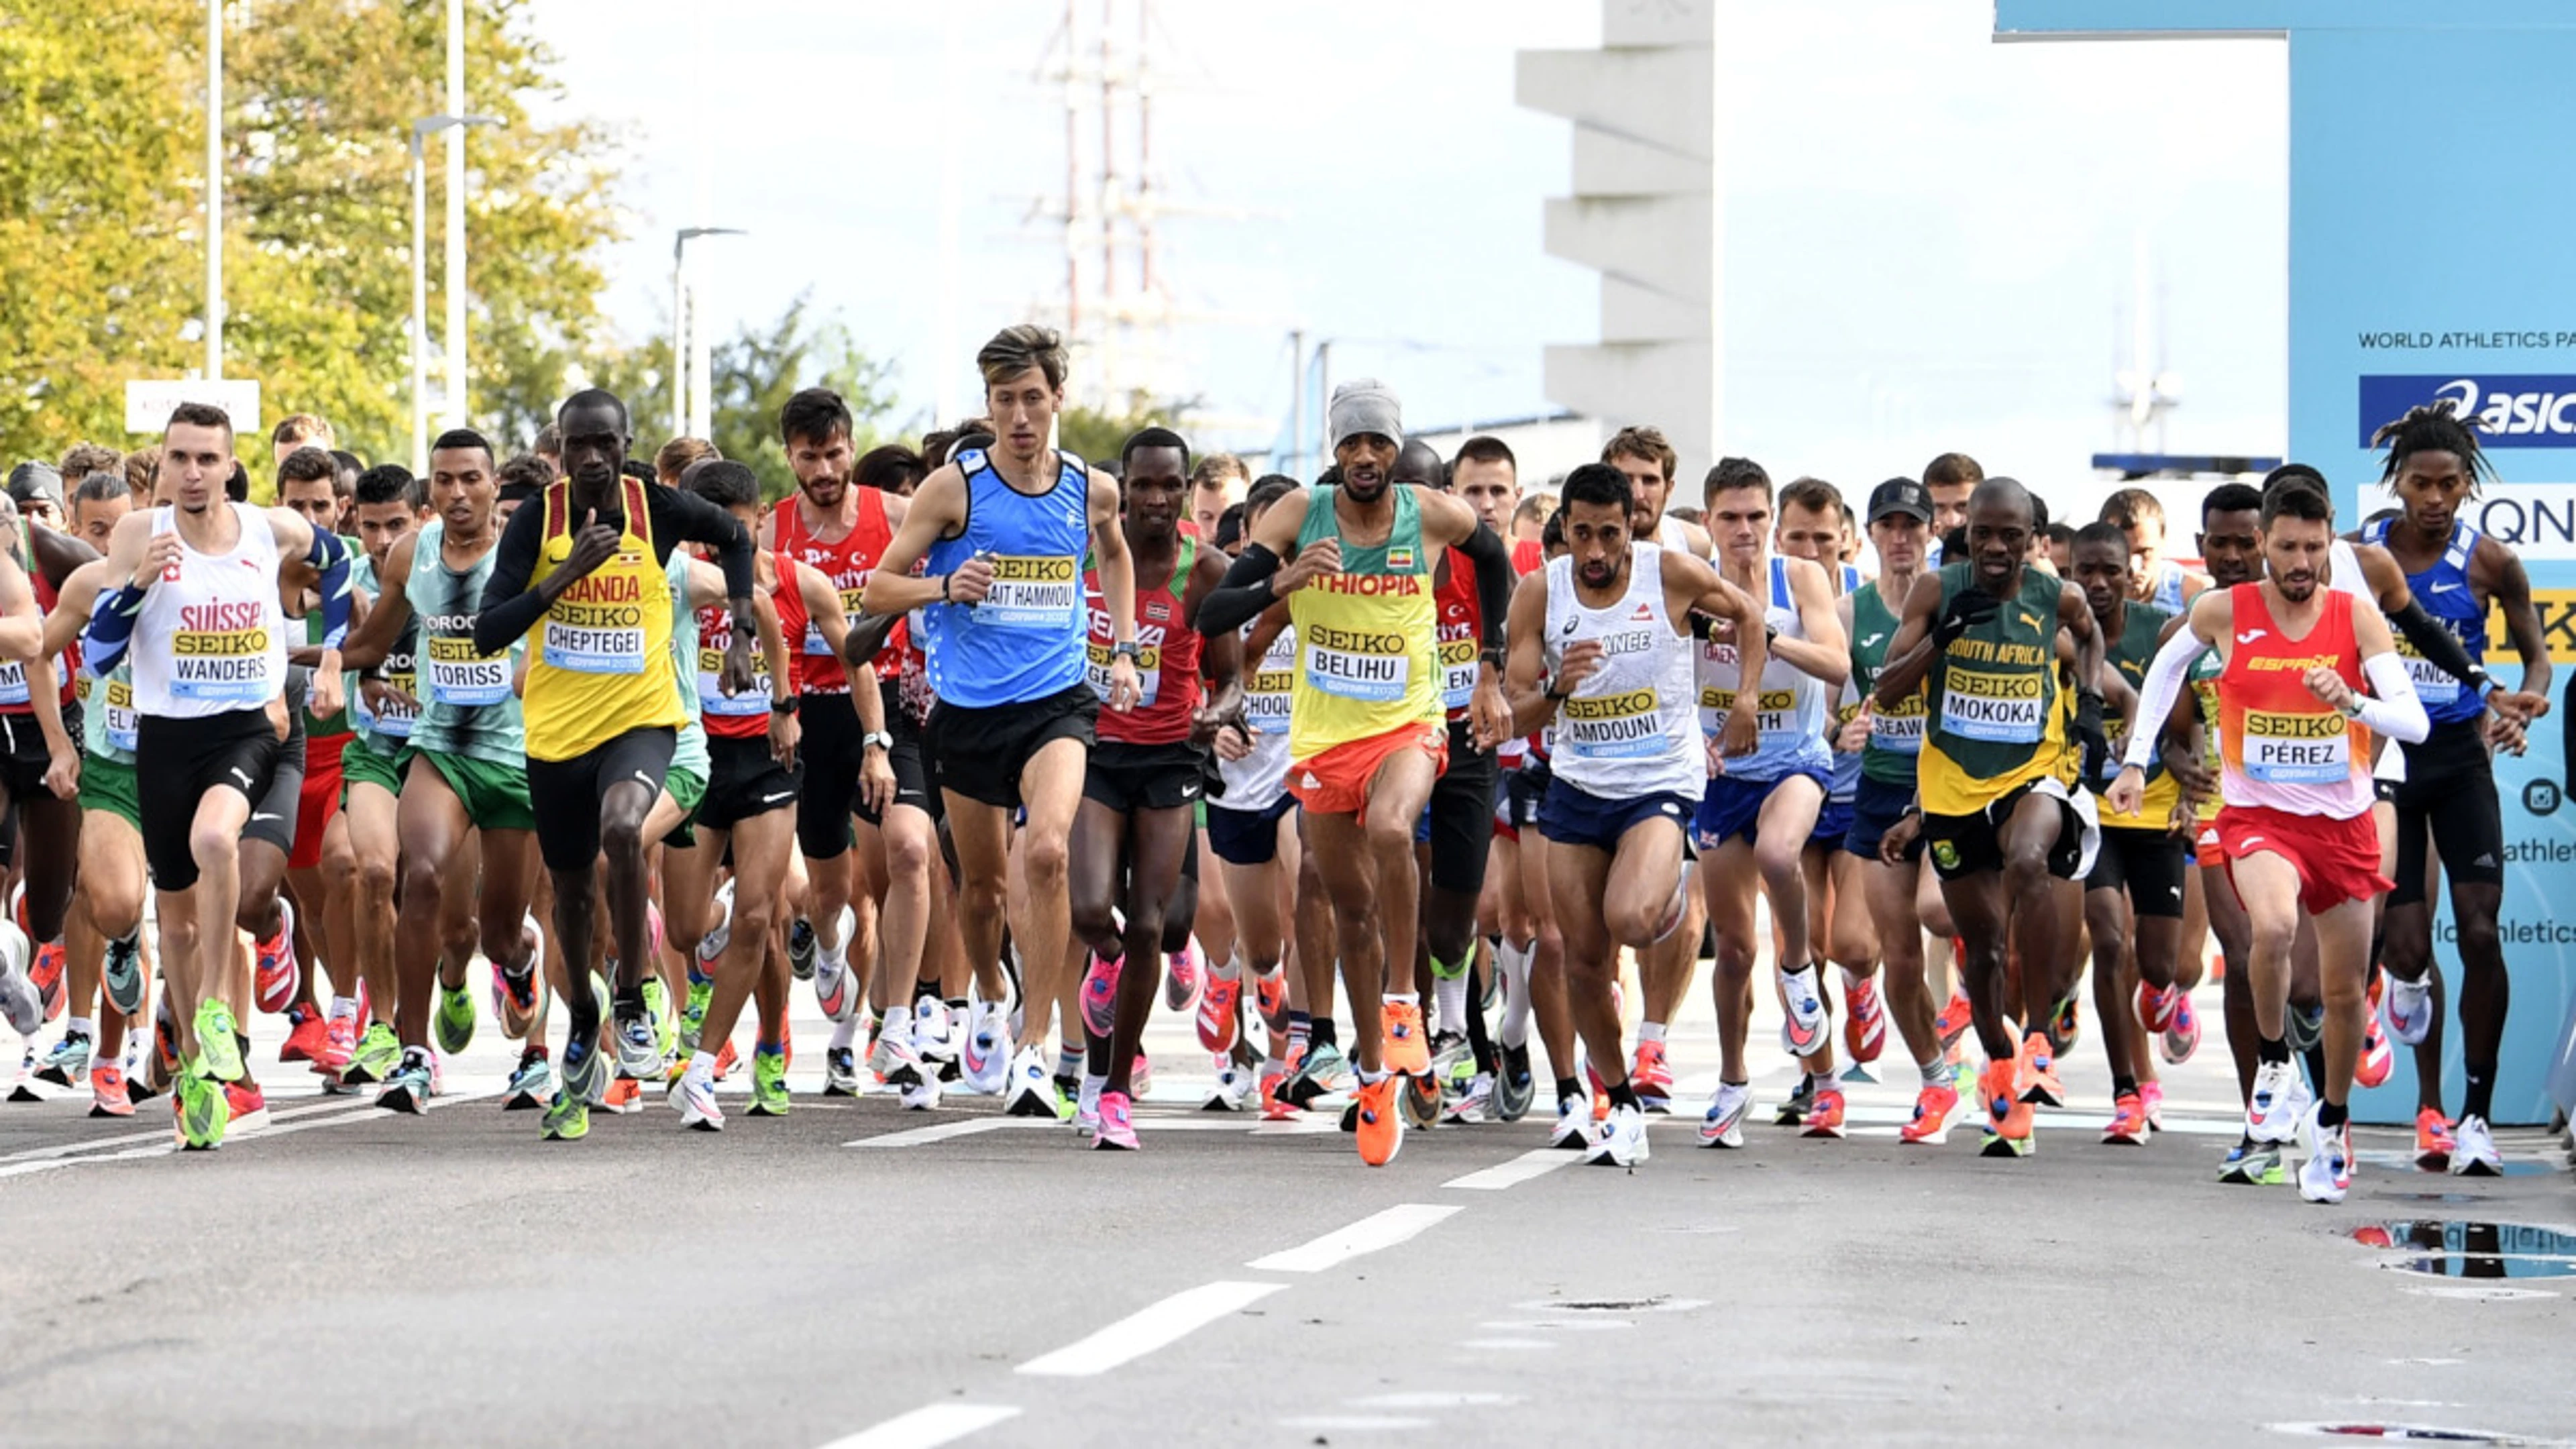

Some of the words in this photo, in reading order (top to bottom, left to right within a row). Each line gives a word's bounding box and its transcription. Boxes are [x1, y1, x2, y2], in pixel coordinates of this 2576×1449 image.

[2359, 332, 2433, 348] WORLD
[2438, 332, 2551, 348] ATHLETICS
[2478, 392, 2576, 434] asic
[2479, 498, 2575, 545] QN
[1015, 585, 1072, 607] HAMMOU
[549, 604, 641, 626] SEIKO
[174, 631, 267, 655] SEIKO
[549, 625, 639, 653] CHEPTEGEI
[1309, 624, 1405, 654] SEIKO
[1315, 651, 1396, 680] BELIHU
[1996, 643, 2045, 665] AFRICA
[176, 656, 266, 681] WANDERS
[433, 664, 503, 686] TORISS
[1444, 669, 1474, 690] EN
[1948, 672, 2038, 696] SEIKO
[1566, 692, 1652, 718] SEIKO
[1702, 690, 1791, 710] SEKO
[1948, 695, 2036, 722] MOKOKA
[1573, 714, 1658, 743] AMDOUNI
[1716, 711, 1782, 730] STH
[2248, 714, 2345, 737] SEIKO
[2261, 741, 2334, 763] PÉREZ
